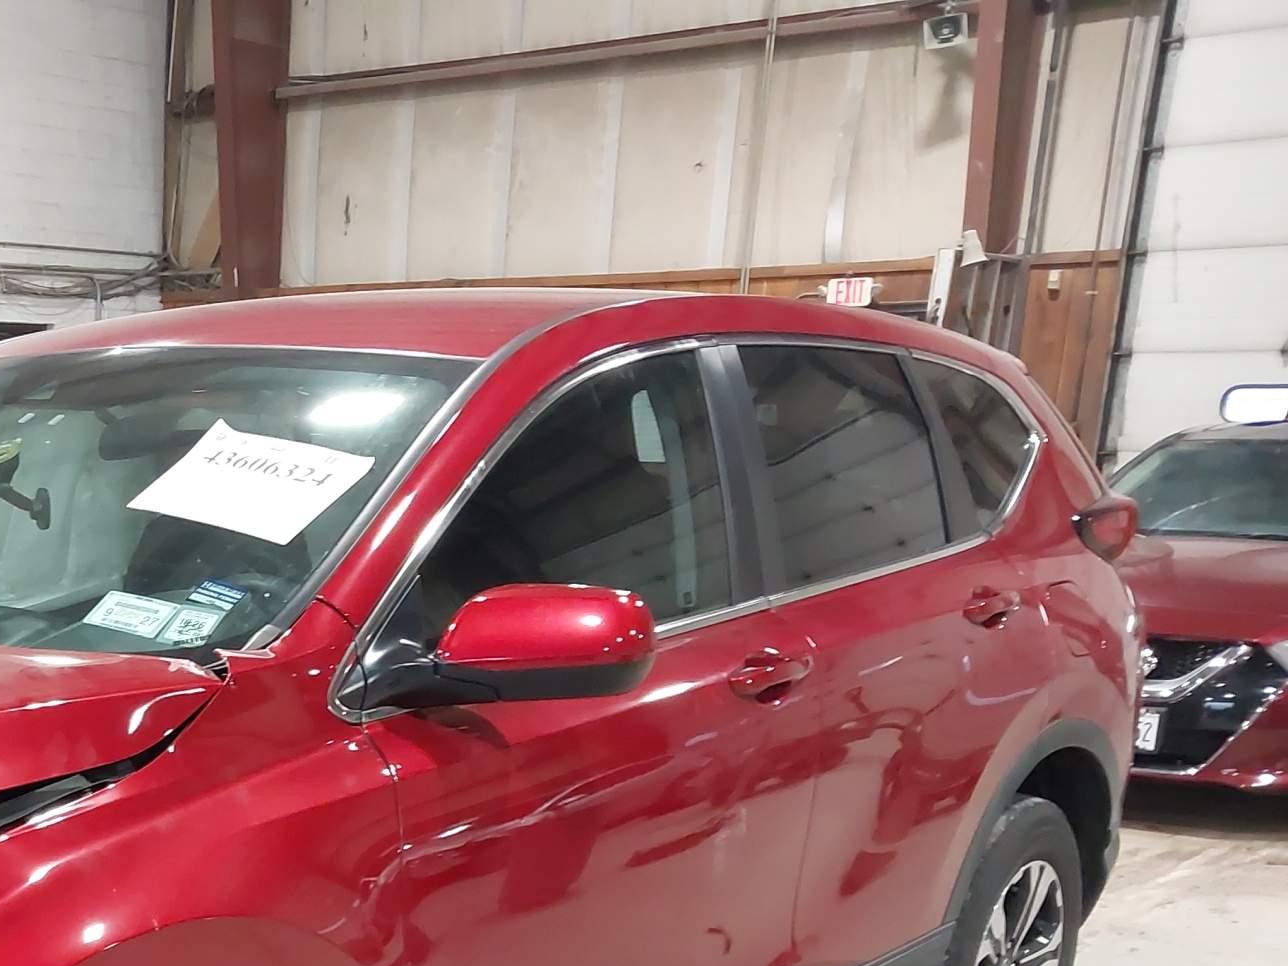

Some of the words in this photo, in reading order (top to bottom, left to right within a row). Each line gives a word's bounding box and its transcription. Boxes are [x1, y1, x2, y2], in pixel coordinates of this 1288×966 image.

[835, 280, 866, 304] EXIT
[203, 449, 333, 486] 43606324
[139, 615, 161, 626] 27
